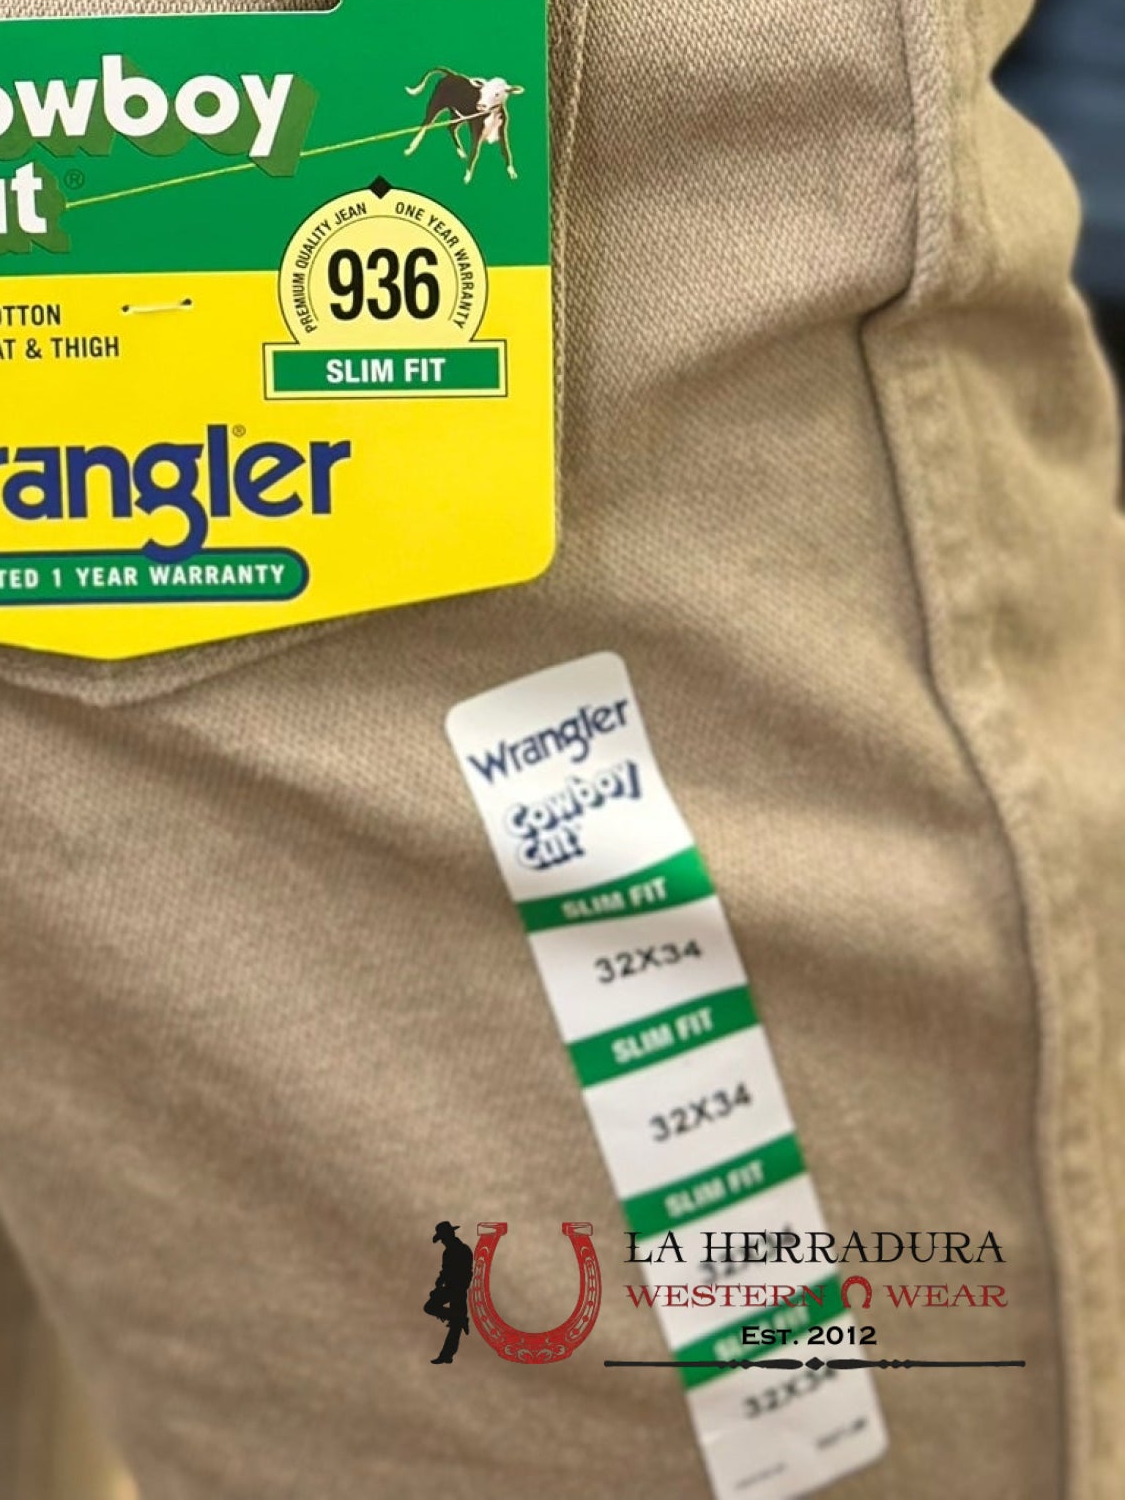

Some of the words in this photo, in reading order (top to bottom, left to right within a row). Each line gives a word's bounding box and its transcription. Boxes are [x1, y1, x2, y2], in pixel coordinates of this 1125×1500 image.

[335, 202, 368, 225] JEAN
[296, 219, 332, 269] QUALITY
[394, 202, 426, 221] ONE
[427, 214, 460, 248] YEAR
[453, 248, 475, 329] WARRANTY
[292, 273, 318, 334] PREMIUM
[327, 247, 441, 321] 936
[25, 338, 43, 359] &
[50, 336, 120, 358] THIGH
[326, 358, 394, 383] SLIM
[405, 358, 446, 382] FIT
[52, 568, 62, 588] 1
[75, 566, 139, 587] YEAR
[148, 563, 286, 586] WARRANTY
[467, 698, 628, 785] Wrangler
[505, 759, 642, 839] Cowboy
[517, 826, 586, 870] Cut
[561, 890, 625, 920] SLIM
[629, 876, 667, 908] FIT
[594, 938, 703, 984] 32X34
[611, 1022, 674, 1064] SLIM
[675, 1007, 713, 1041] FIT
[649, 1081, 752, 1142] 32X34
[665, 1176, 727, 1218] SLIM
[726, 1160, 765, 1193] FIT
